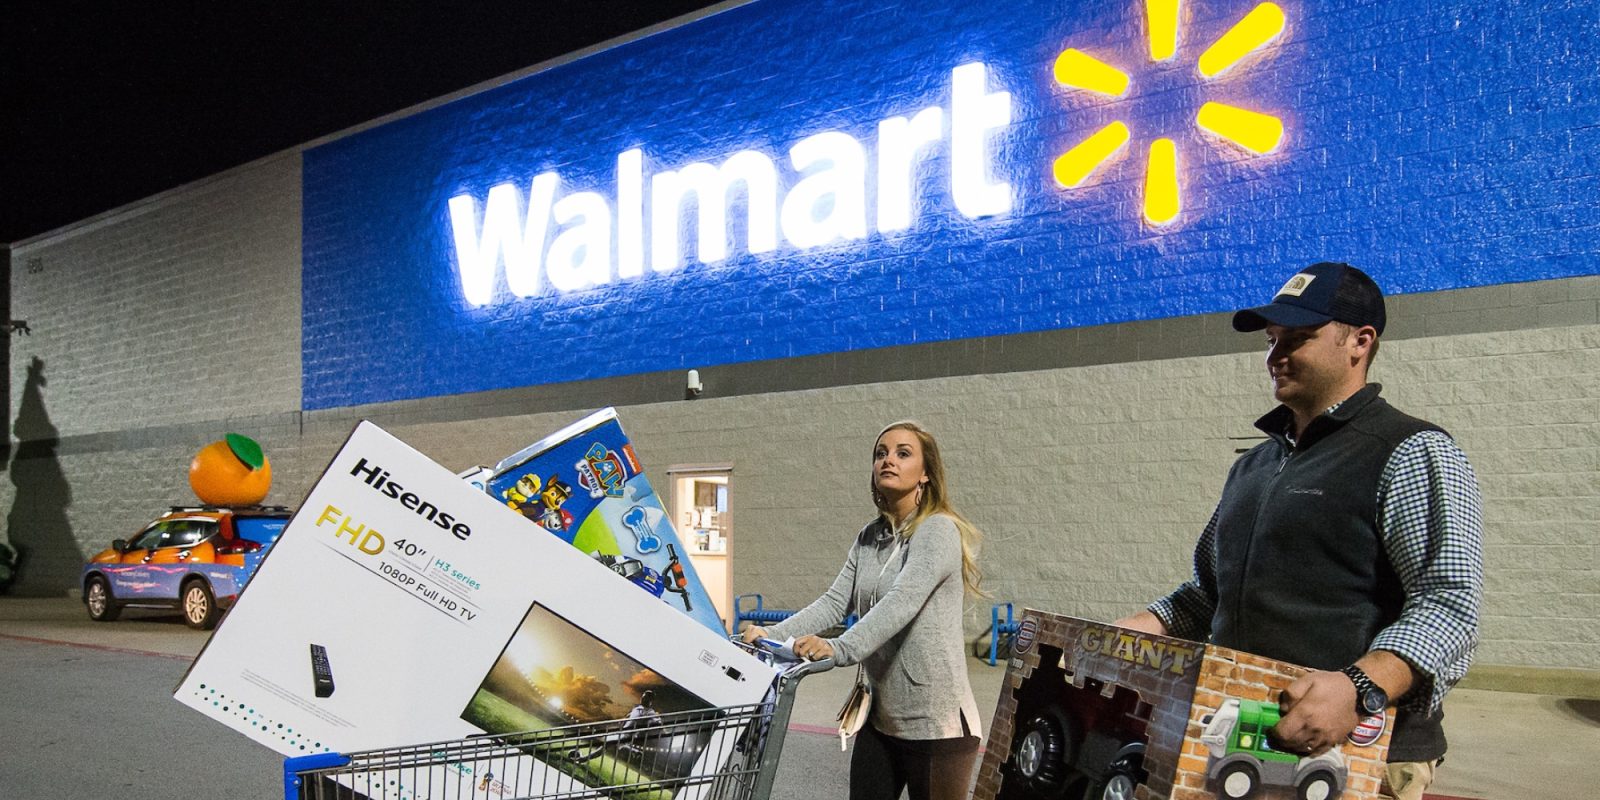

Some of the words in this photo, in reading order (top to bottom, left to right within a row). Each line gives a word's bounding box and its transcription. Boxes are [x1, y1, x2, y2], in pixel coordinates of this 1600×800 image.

[448, 61, 1012, 306] Walmart
[580, 463, 600, 493] PATROL
[585, 441, 624, 497] PAW
[350, 457, 471, 541] Hisense
[315, 504, 386, 556] FHD
[378, 561, 415, 586] 1080P
[416, 583, 439, 602] Full
[438, 595, 457, 612] HD
[460, 607, 477, 621] TV
[434, 558, 451, 573] H3
[452, 568, 481, 591] series
[1080, 626, 1195, 676] GIANT
